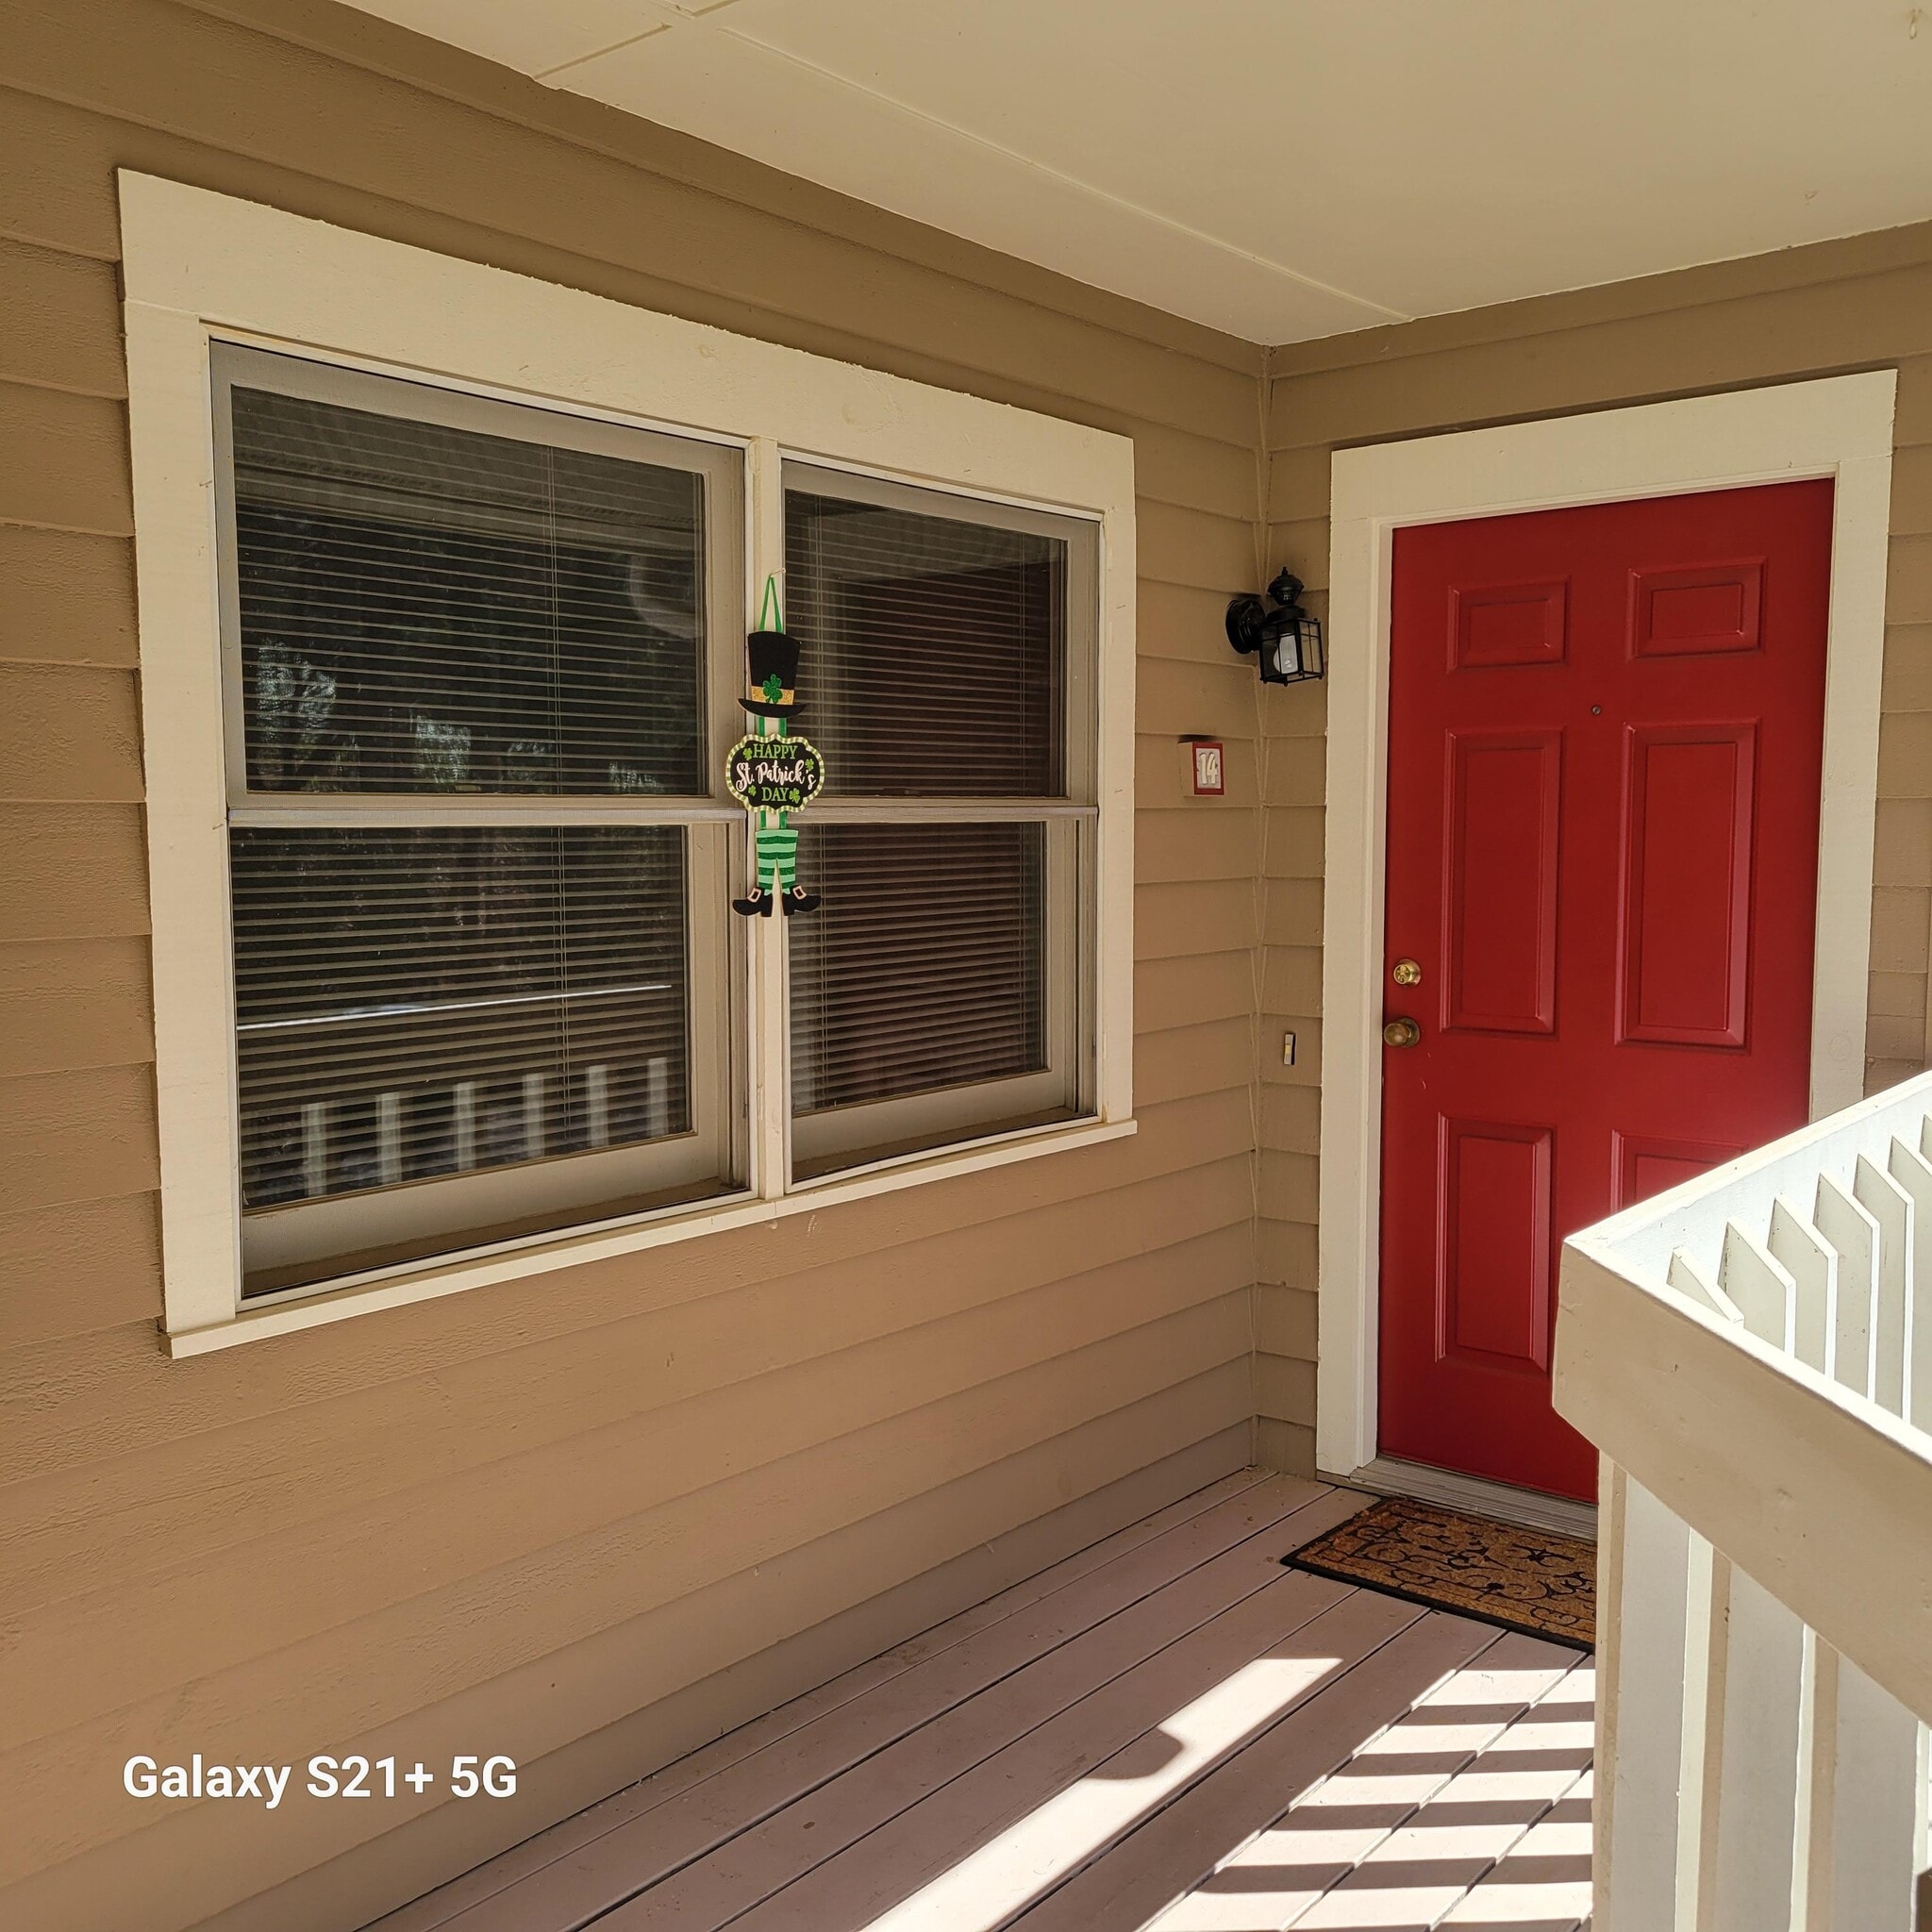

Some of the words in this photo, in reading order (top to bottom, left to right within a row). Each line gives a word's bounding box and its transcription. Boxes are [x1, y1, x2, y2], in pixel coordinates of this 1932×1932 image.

[753, 743, 798, 759] HAPPY
[736, 762, 755, 792] St.
[756, 759, 816, 791] Patrick's
[1199, 753, 1218, 785] 14
[761, 787, 790, 802] DAY
